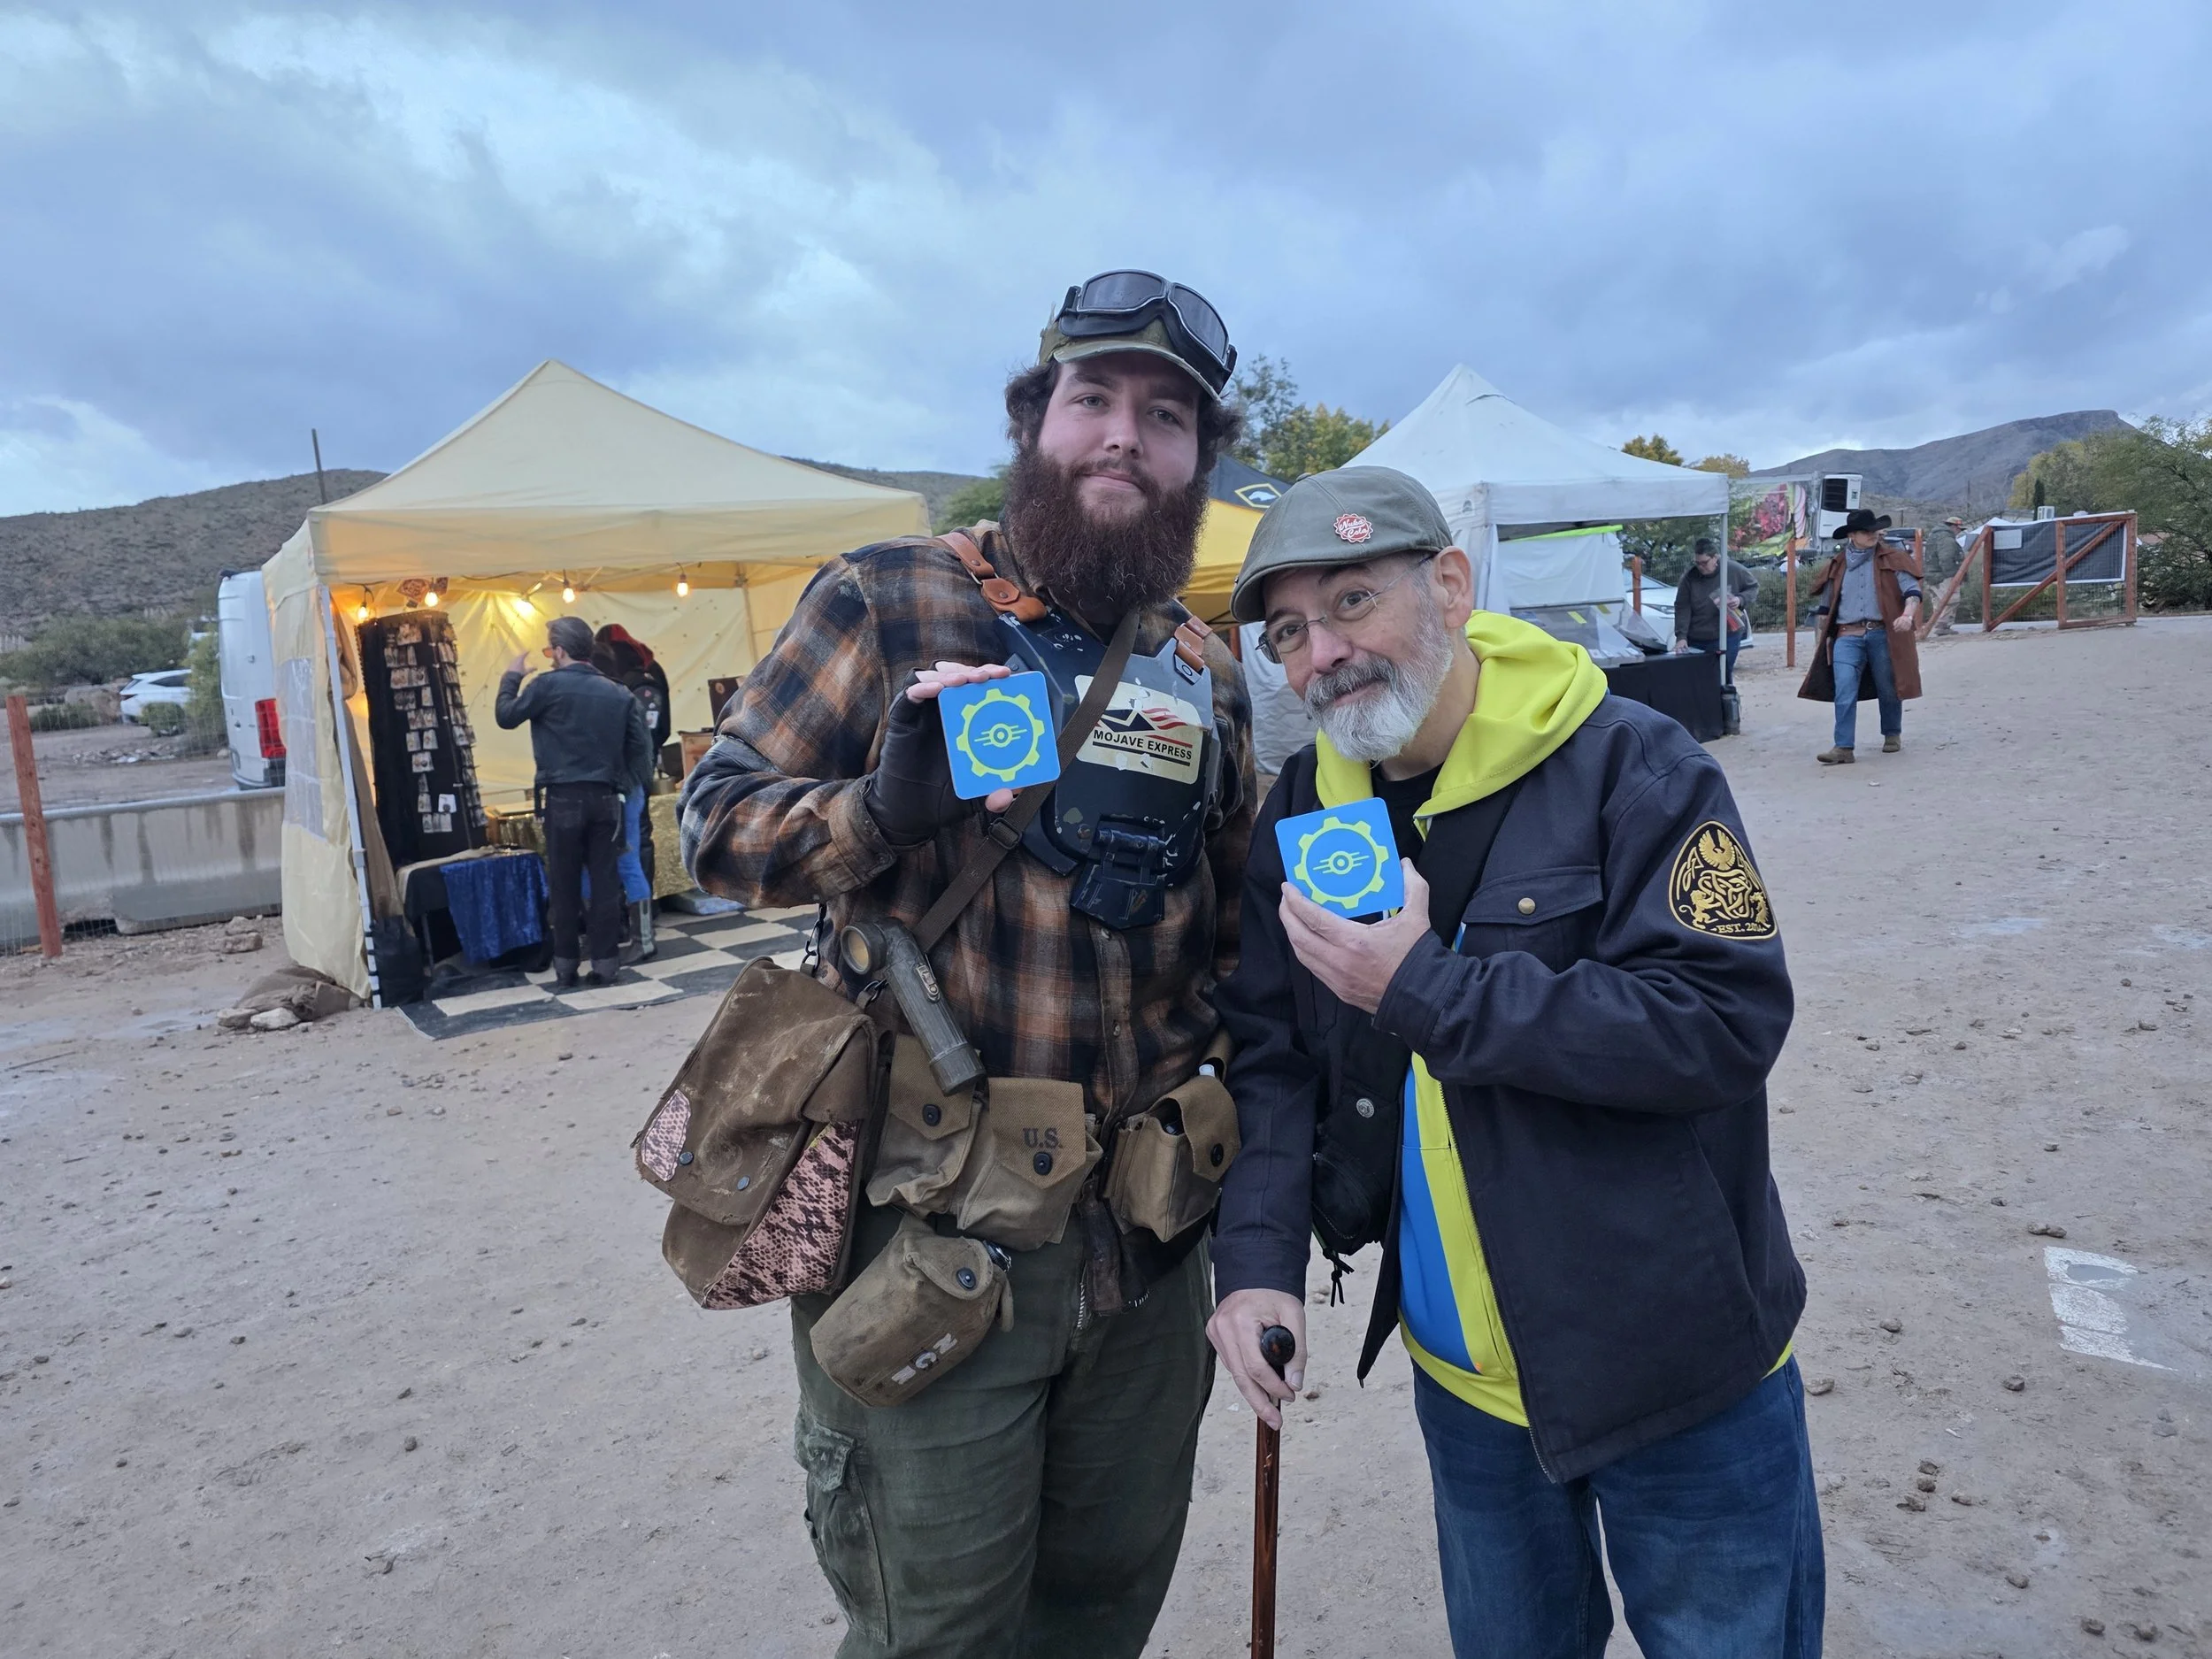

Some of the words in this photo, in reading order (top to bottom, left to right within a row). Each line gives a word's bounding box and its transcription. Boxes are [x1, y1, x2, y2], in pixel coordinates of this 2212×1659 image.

[1340, 518, 1364, 531] Nuka
[1347, 528, 1368, 538] Cola
[1094, 730, 1144, 748] MOJAVE
[1148, 741, 1192, 760] EXPRESS
[1717, 923, 1745, 933] EST.
